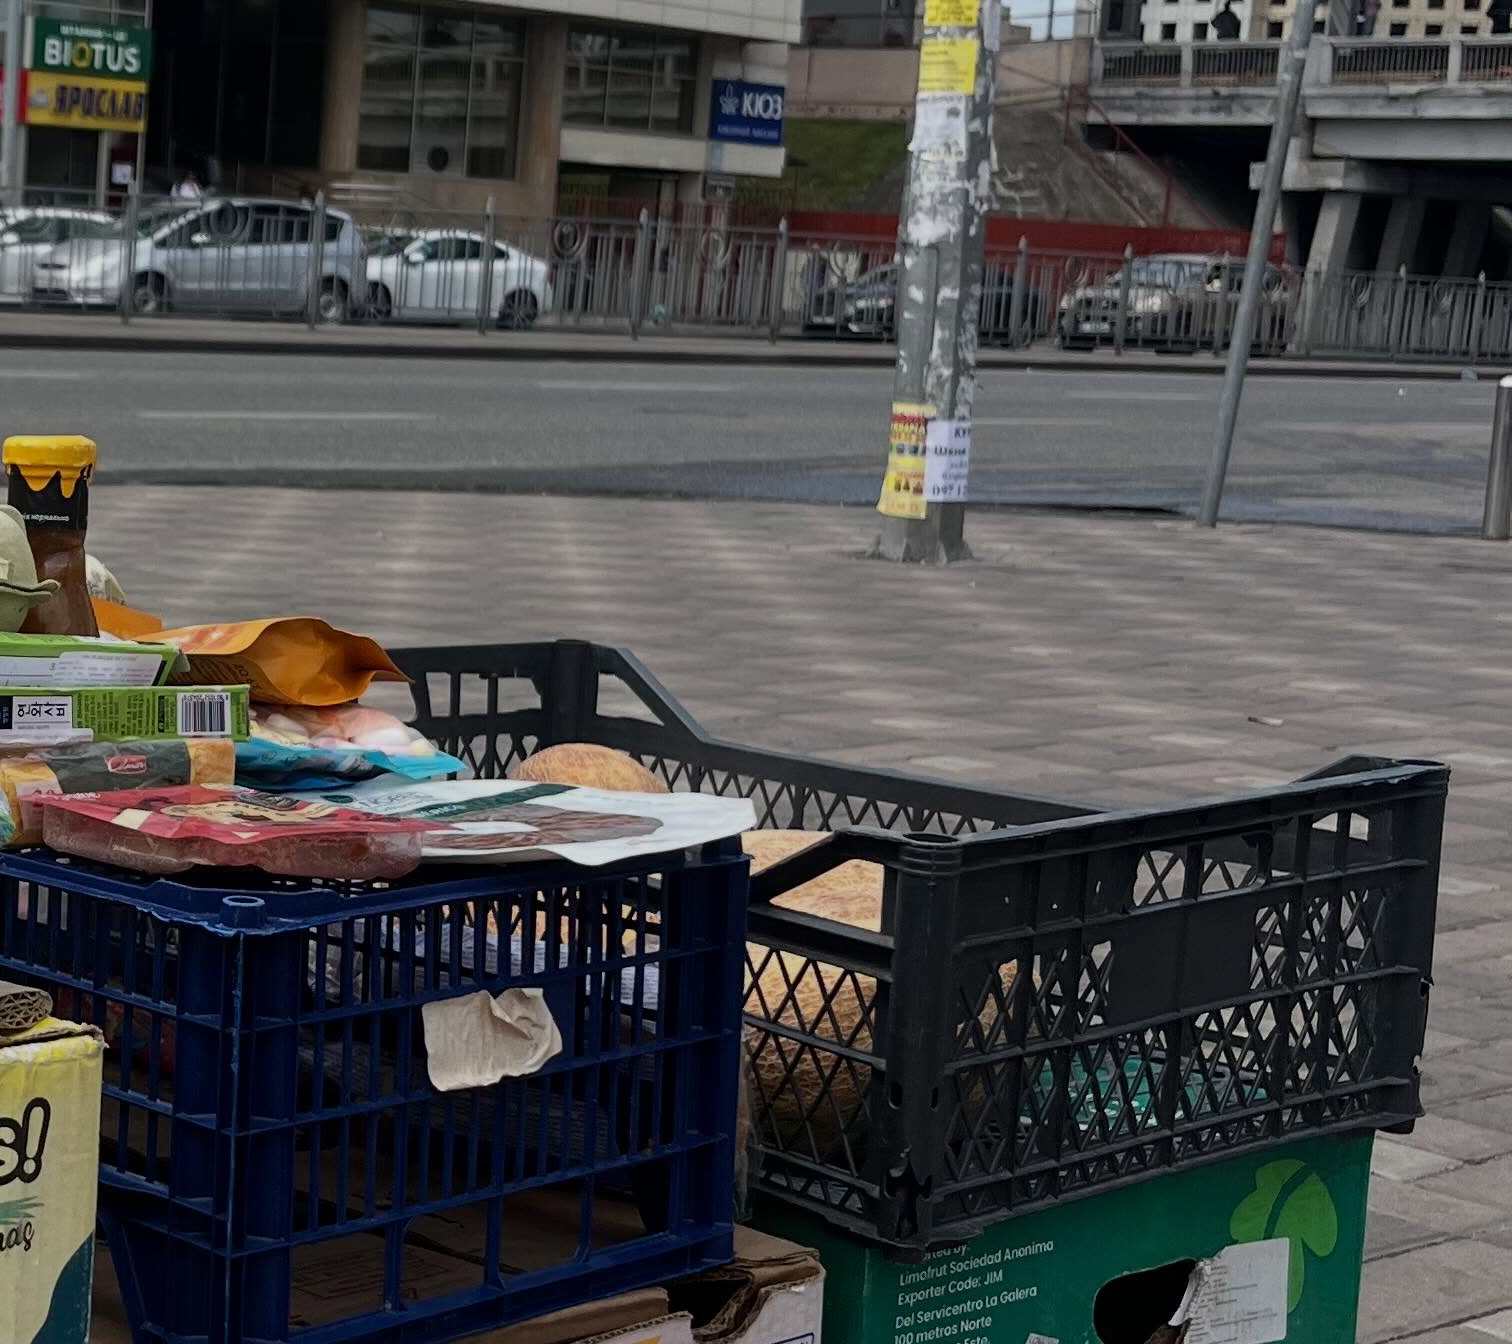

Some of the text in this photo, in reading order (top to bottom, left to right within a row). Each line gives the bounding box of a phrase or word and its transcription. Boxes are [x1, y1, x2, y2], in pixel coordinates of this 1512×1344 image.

[44, 37, 140, 73] BIOTUS
[17, 700, 68, 719] 연와사비
[899, 1264, 947, 1287] Limofrut
[949, 1249, 1002, 1275] Sociedad
[1003, 1239, 1054, 1263] Anonima
[897, 1269, 1004, 1307] Exporter Code: JIM
[895, 1285, 1038, 1329] Del Servicentro La Galera
[915, 1323, 958, 1343] metros
[960, 1315, 993, 1333] Norte
